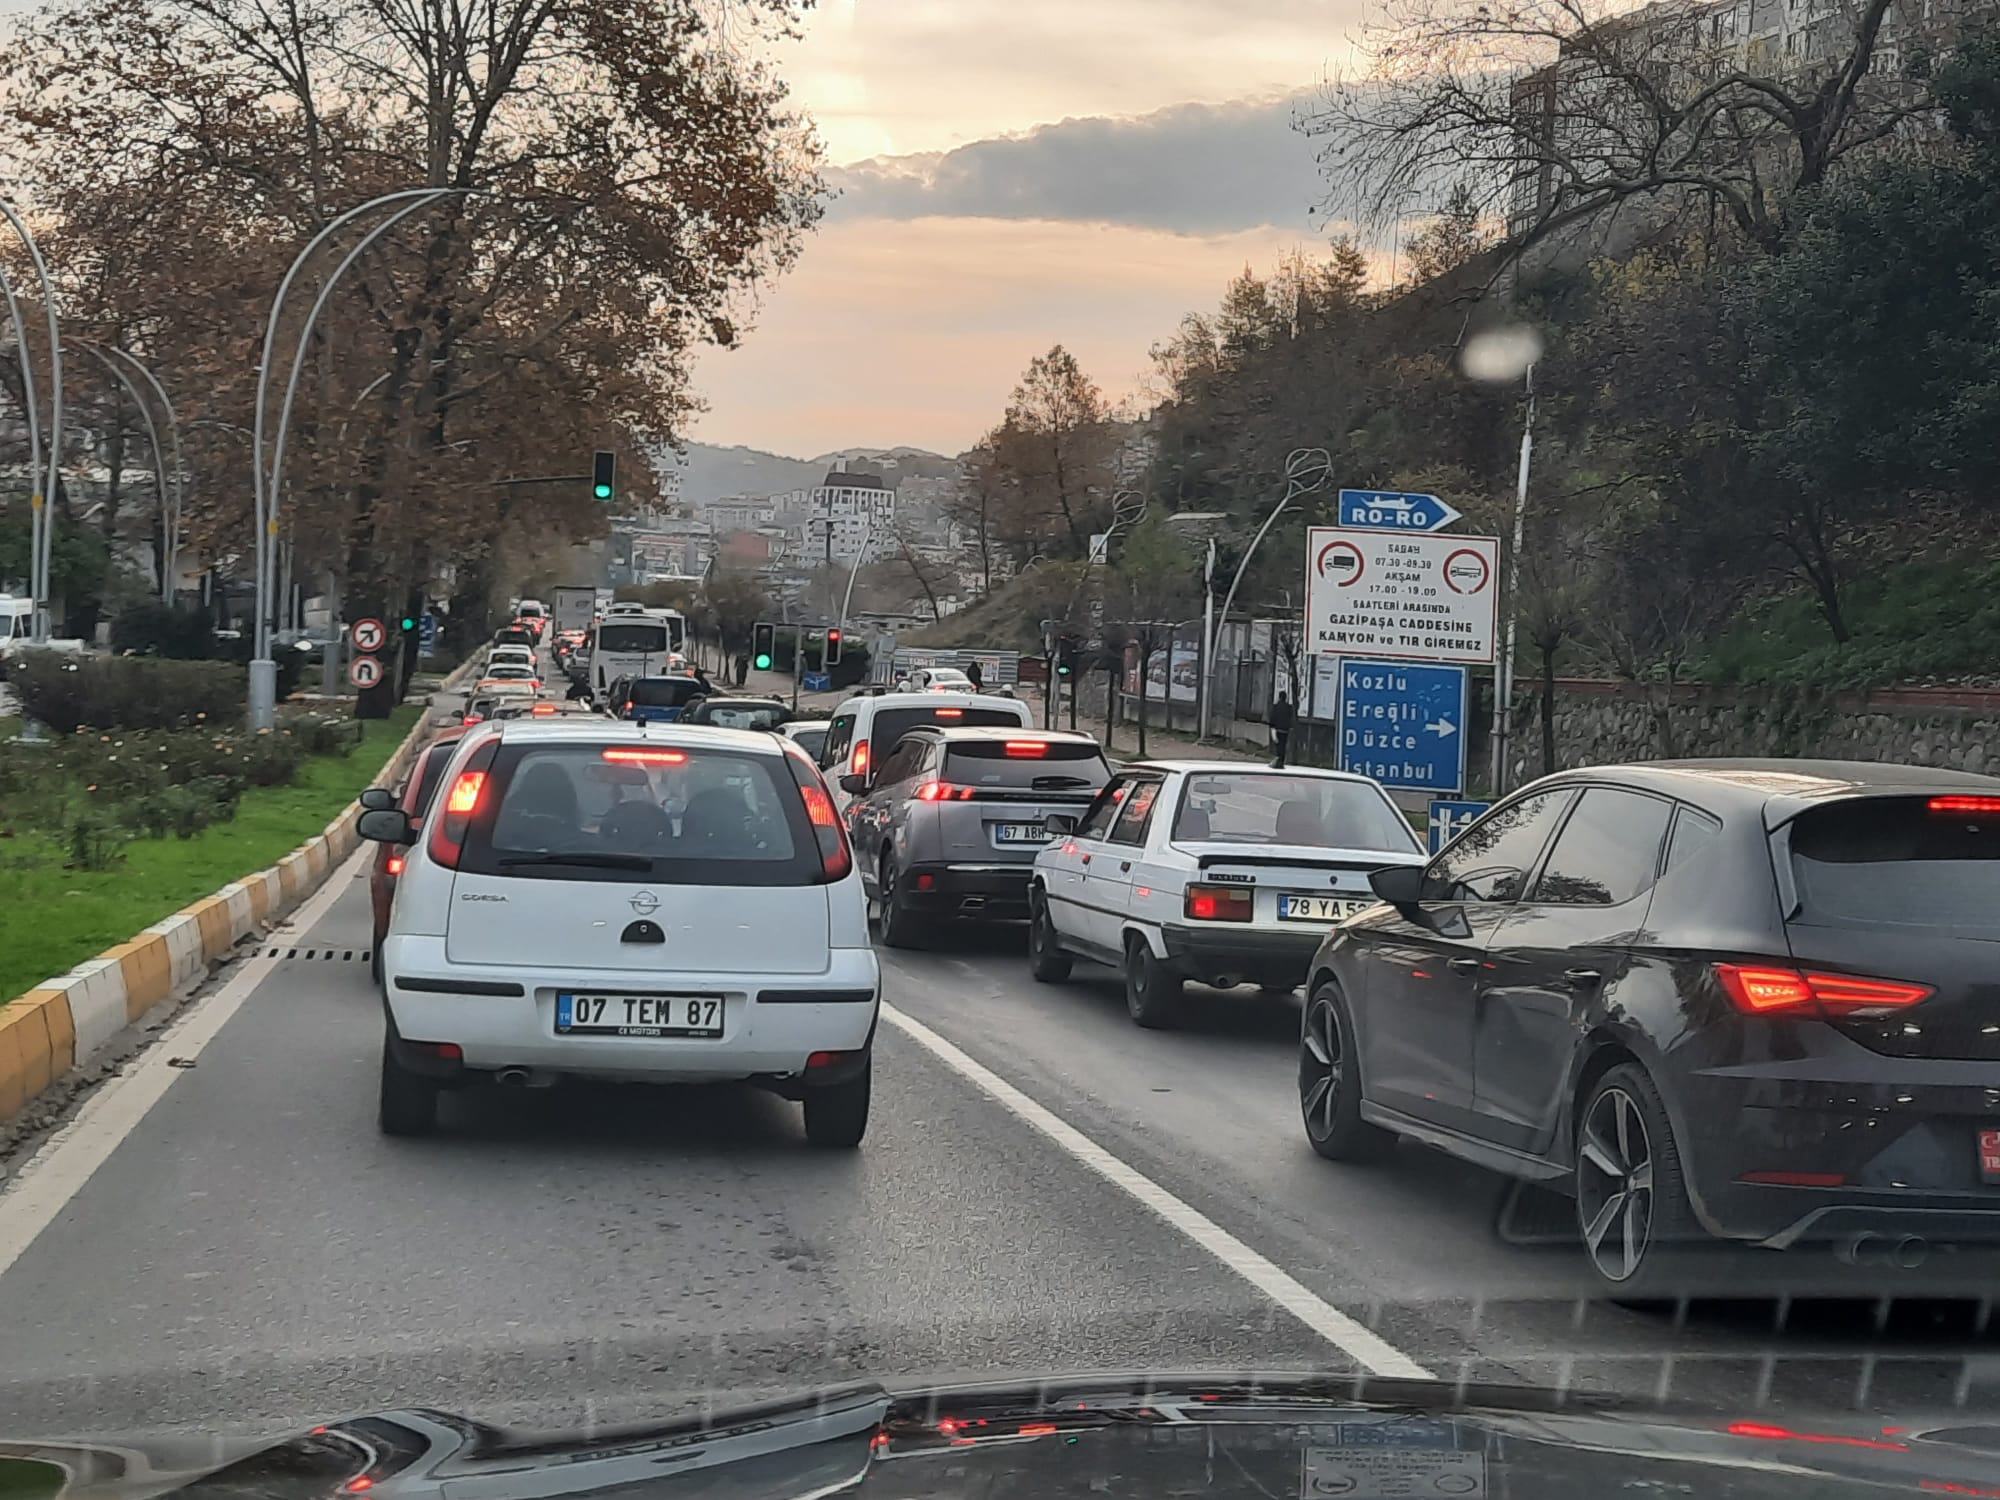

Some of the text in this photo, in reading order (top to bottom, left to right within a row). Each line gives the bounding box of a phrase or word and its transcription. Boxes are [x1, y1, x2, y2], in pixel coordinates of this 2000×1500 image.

[1352, 508, 1427, 526] RO-RO
[1385, 572, 1420, 583] AKŞAM
[1353, 600, 1451, 613] SAATLERİ ARASINDA
[1329, 613, 1473, 633] GAZİPAŞA CADDESİNE
[1319, 630, 1375, 645] KAMYON
[1399, 635, 1420, 647] TIR
[1424, 635, 1482, 651] GİREMEZ
[1346, 671, 1407, 690] Kozlu
[1346, 700, 1417, 722] Ereğli
[1346, 729, 1417, 749] Düzce
[1004, 826, 1017, 839] 67
[1289, 898, 1310, 915] 78
[1319, 900, 1341, 917] YA
[576, 998, 718, 1026] 07 TEM 87
